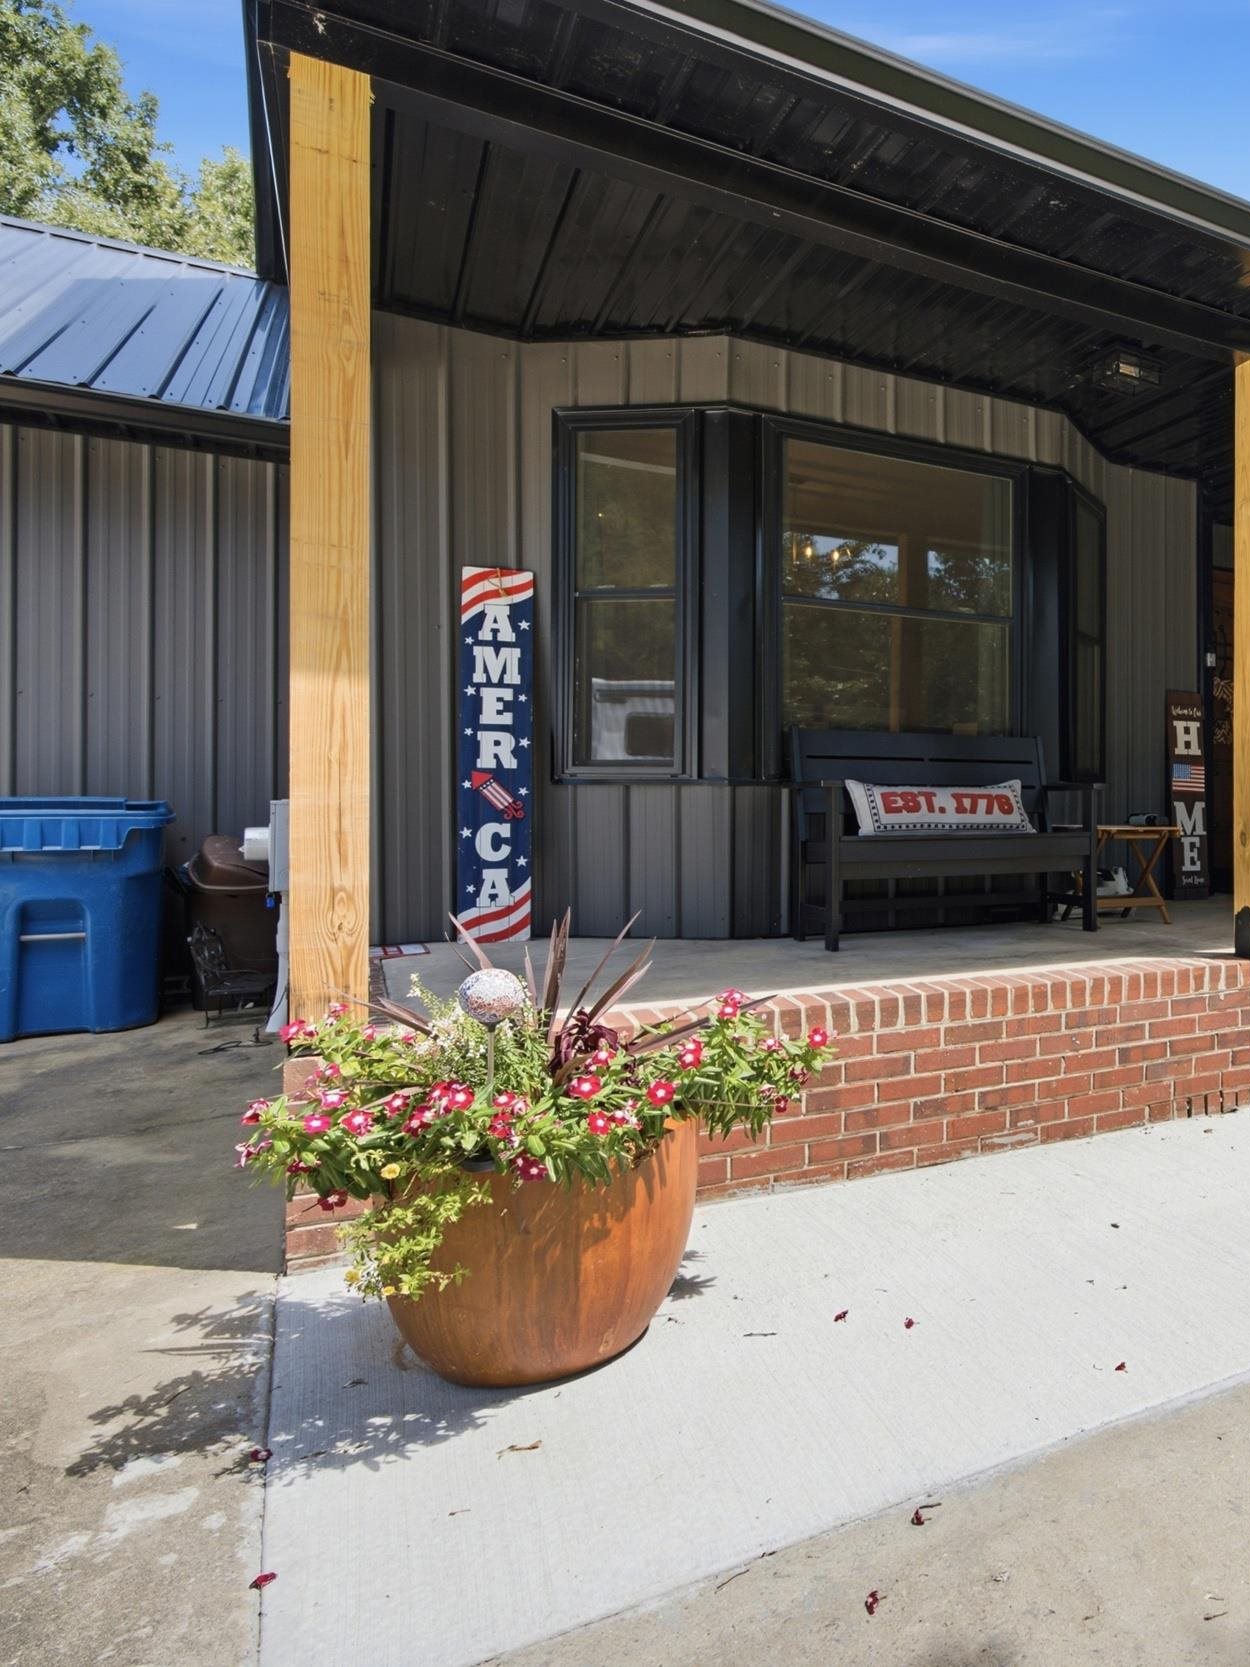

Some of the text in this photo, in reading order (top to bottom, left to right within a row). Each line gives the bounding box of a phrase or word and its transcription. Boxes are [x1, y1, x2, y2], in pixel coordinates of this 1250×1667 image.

[472, 603, 521, 907] AMERCA
[880, 791, 1014, 815] EST. 1776
[1172, 720, 1207, 871] HME
